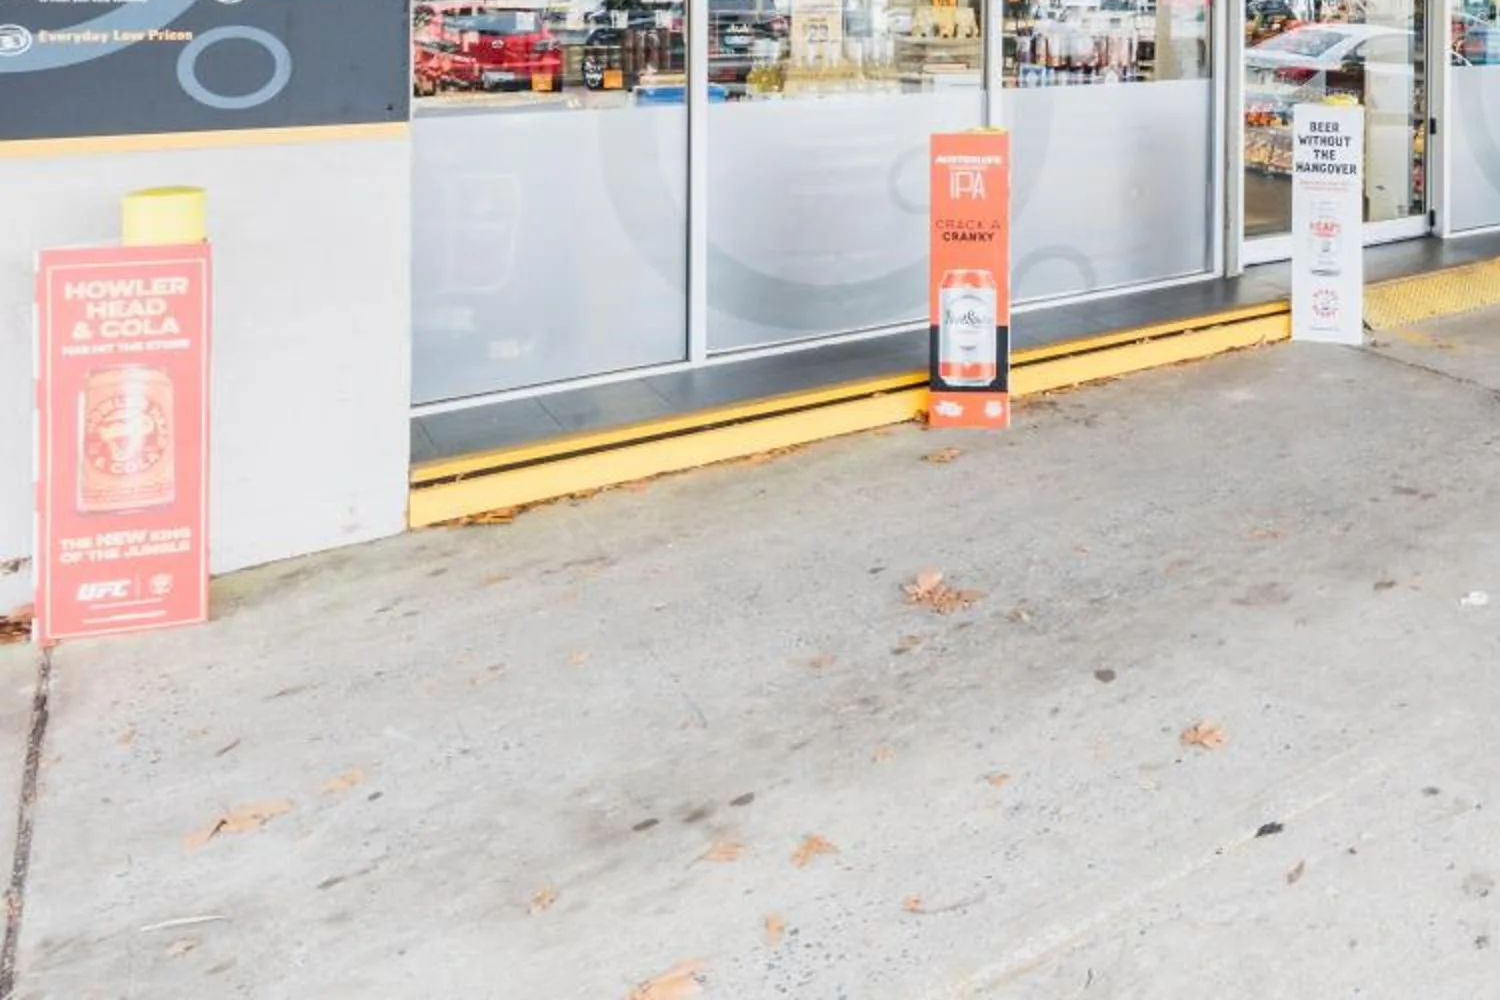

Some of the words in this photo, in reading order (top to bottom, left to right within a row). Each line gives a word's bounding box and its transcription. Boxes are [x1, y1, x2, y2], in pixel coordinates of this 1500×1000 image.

[38, 30, 108, 43] Everyday
[113, 30, 145, 41] Low
[148, 30, 193, 41] Prices
[1309, 121, 1340, 133] BEER
[1298, 135, 1352, 148] WITHOUT
[1313, 149, 1337, 161] THE
[1295, 162, 1357, 175] HANGOVER
[949, 170, 986, 201] IPA
[942, 231, 995, 242] CRANKY
[64, 276, 189, 301] HOWLER
[86, 297, 168, 320] HEAD
[71, 320, 93, 340] &
[100, 316, 181, 338] COLA
[60, 538, 93, 551] THE
[95, 529, 147, 547] NEW
[59, 550, 84, 565] OF
[88, 547, 121, 561] THE
[123, 539, 191, 559] JUNGLE
[76, 578, 132, 601] UFC
